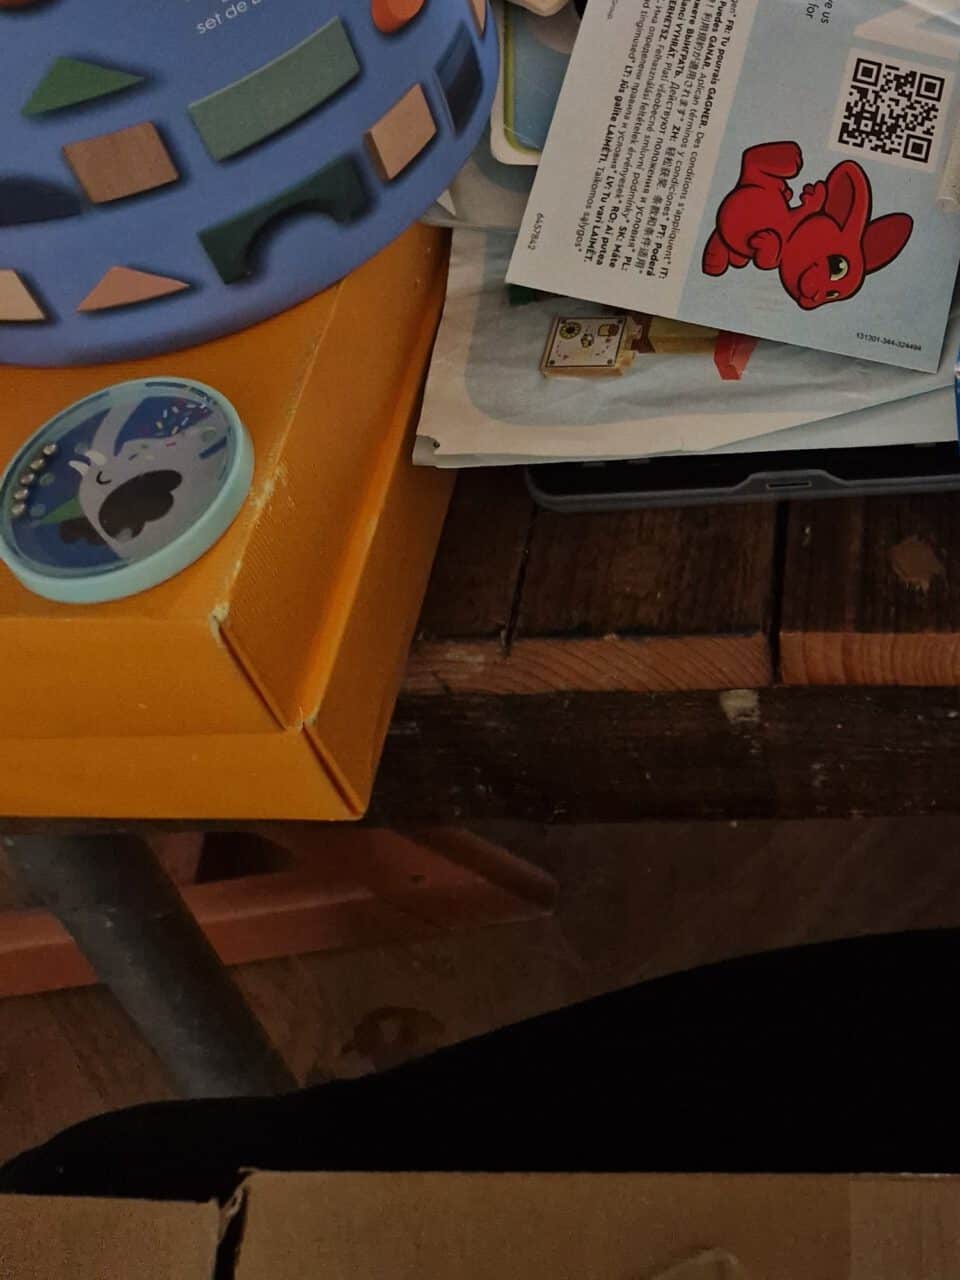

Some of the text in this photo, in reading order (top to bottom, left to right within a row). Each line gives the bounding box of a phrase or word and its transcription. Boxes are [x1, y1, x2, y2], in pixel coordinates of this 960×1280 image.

[197, 14, 222, 34] set
[225, 0, 247, 19] de
[711, 0, 728, 33] Puedes
[806, 1, 819, 19] for
[820, 10, 830, 24] us
[701, 34, 718, 69] GANAR.
[719, 35, 731, 48] Tu
[709, 47, 726, 85] pourrais
[691, 71, 707, 106] Aplican
[609, 94, 623, 122] galite
[698, 86, 717, 129] GAGNER.
[668, 123, 681, 142] ZH:
[679, 107, 698, 149] términos
[692, 130, 705, 149] Des
[584, 166, 604, 209] Taikomos
[679, 150, 698, 200] conditions
[594, 204, 606, 224] vari
[607, 205, 619, 224] RO:
[615, 225, 627, 242] SK:
[655, 223, 668, 240] PT:
[595, 235, 610, 266] putea
[645, 241, 663, 277] Poderá
